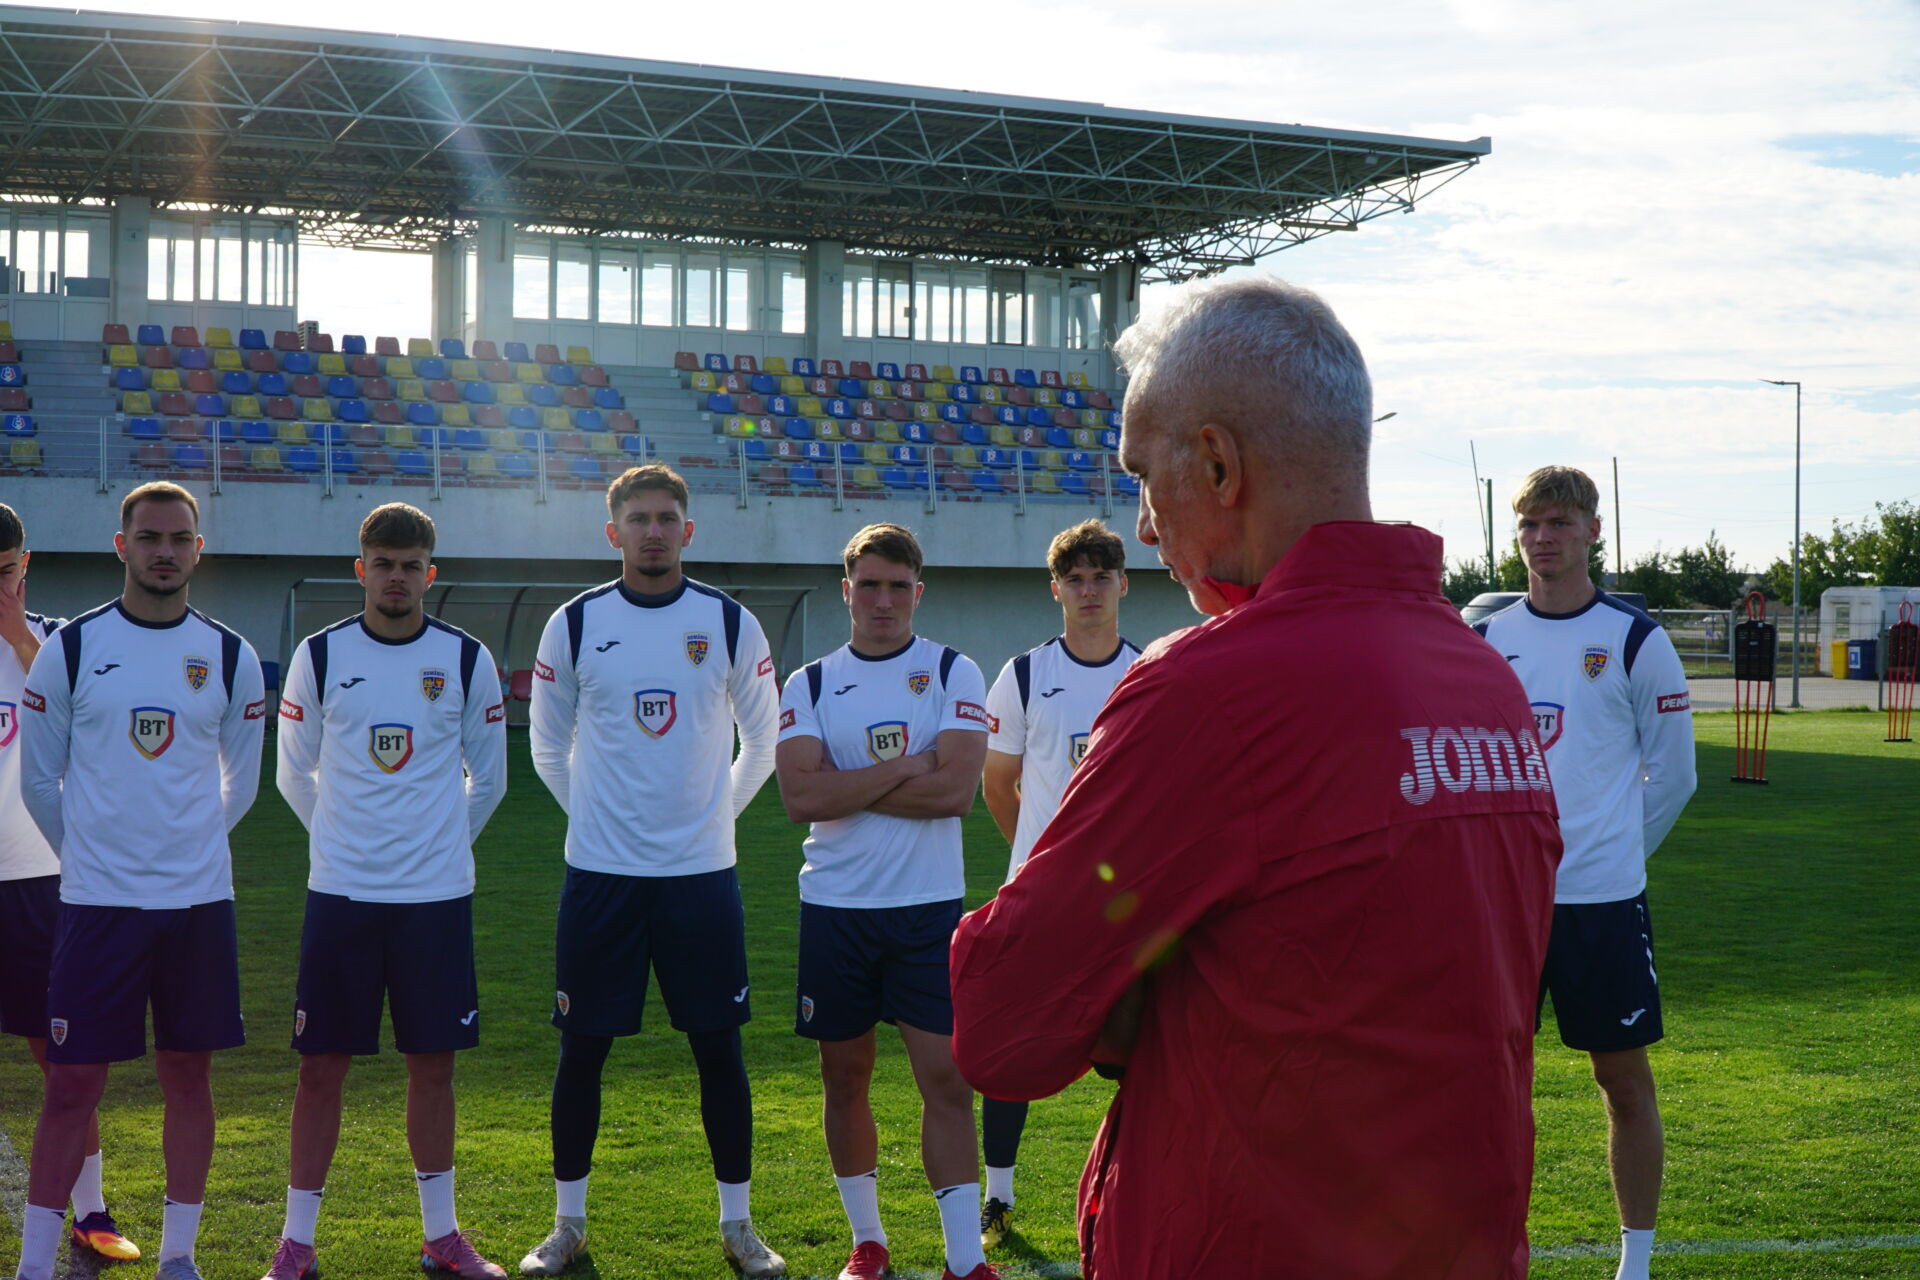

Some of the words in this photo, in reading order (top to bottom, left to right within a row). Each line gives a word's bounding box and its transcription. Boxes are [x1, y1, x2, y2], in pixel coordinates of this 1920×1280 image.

[642, 701, 668, 717] BT
[139, 719, 166, 736] BT
[378, 735, 404, 751] BT
[875, 732, 901, 750] BT
